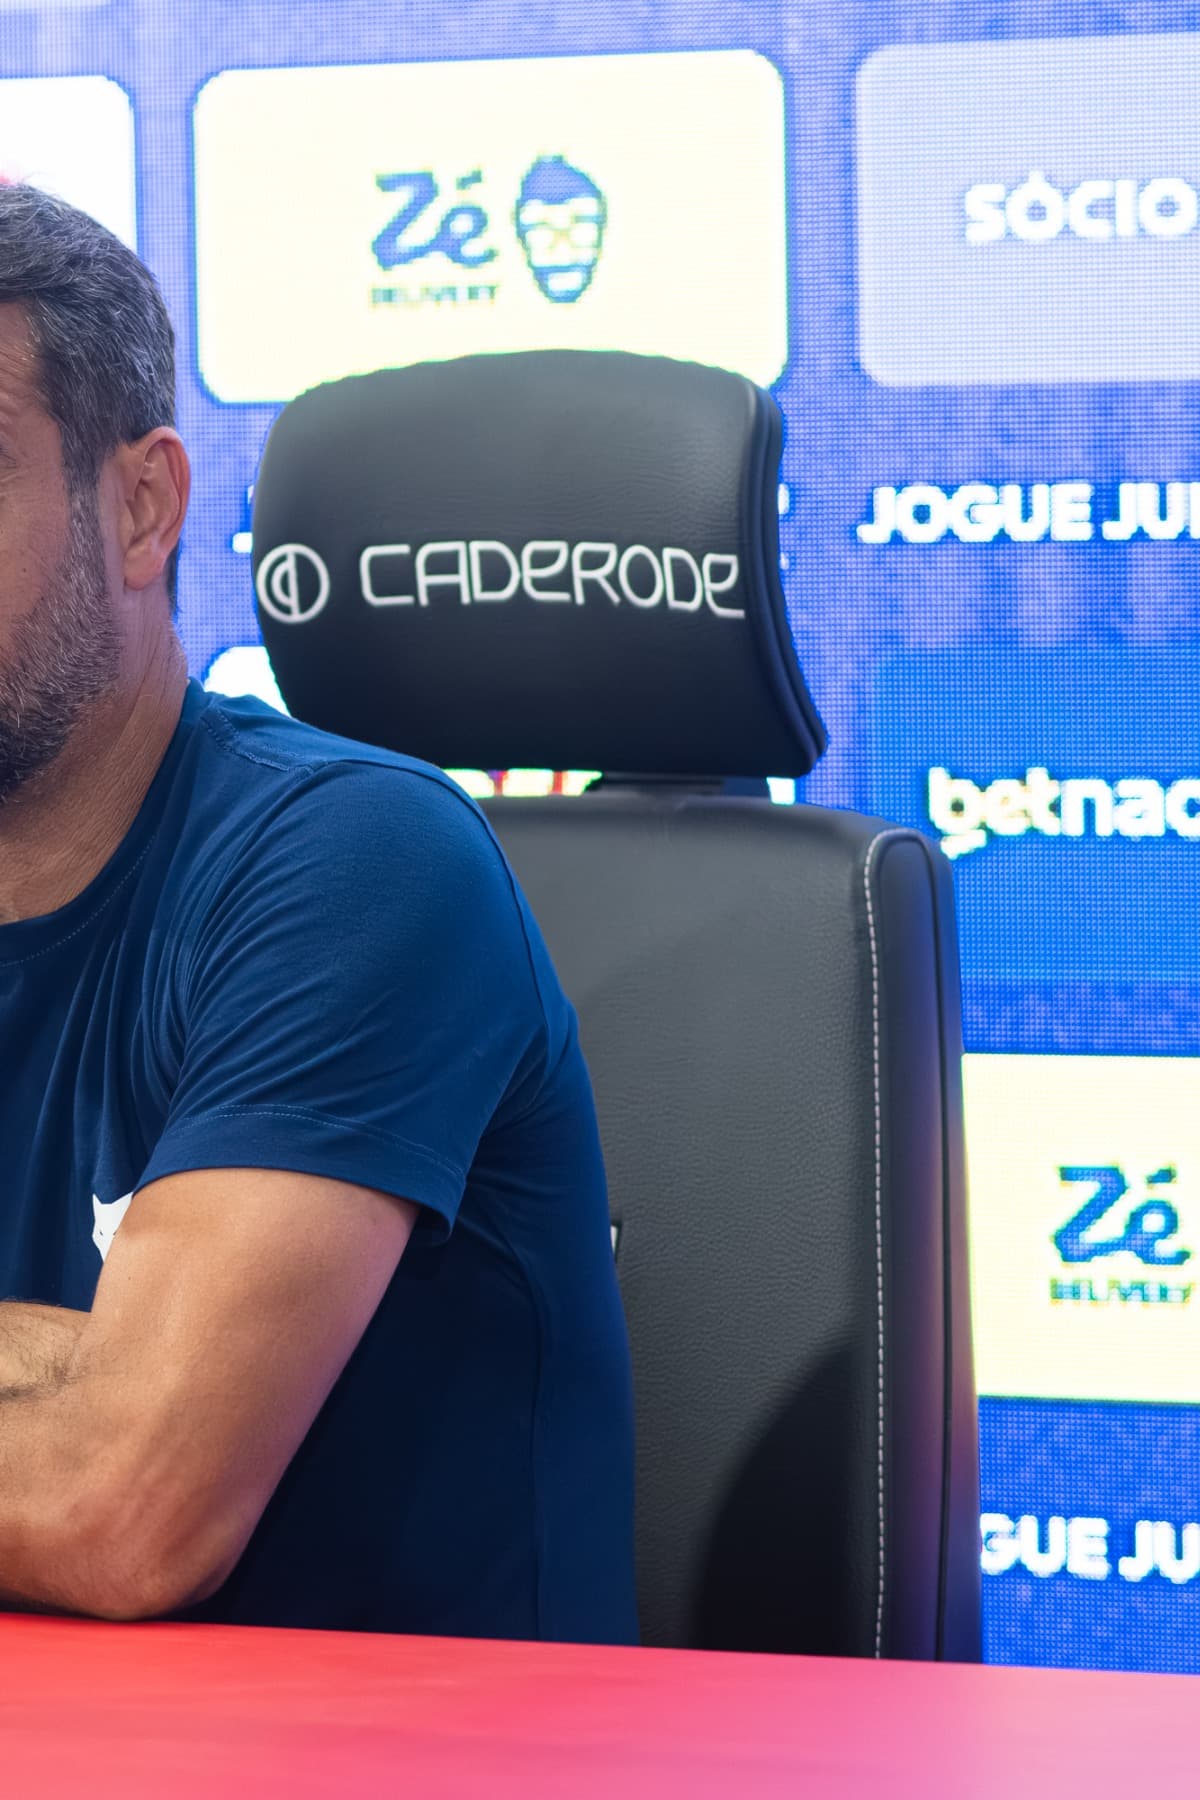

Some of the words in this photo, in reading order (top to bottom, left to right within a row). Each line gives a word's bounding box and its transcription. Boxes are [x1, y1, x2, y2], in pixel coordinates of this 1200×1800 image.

[372, 169, 499, 271] Zé
[965, 170, 1188, 241] SÓCIO
[856, 481, 1093, 544] JOGUE
[1102, 480, 1200, 541] JU
[359, 541, 744, 619] CADERODE
[1054, 1165, 1191, 1266] Zé
